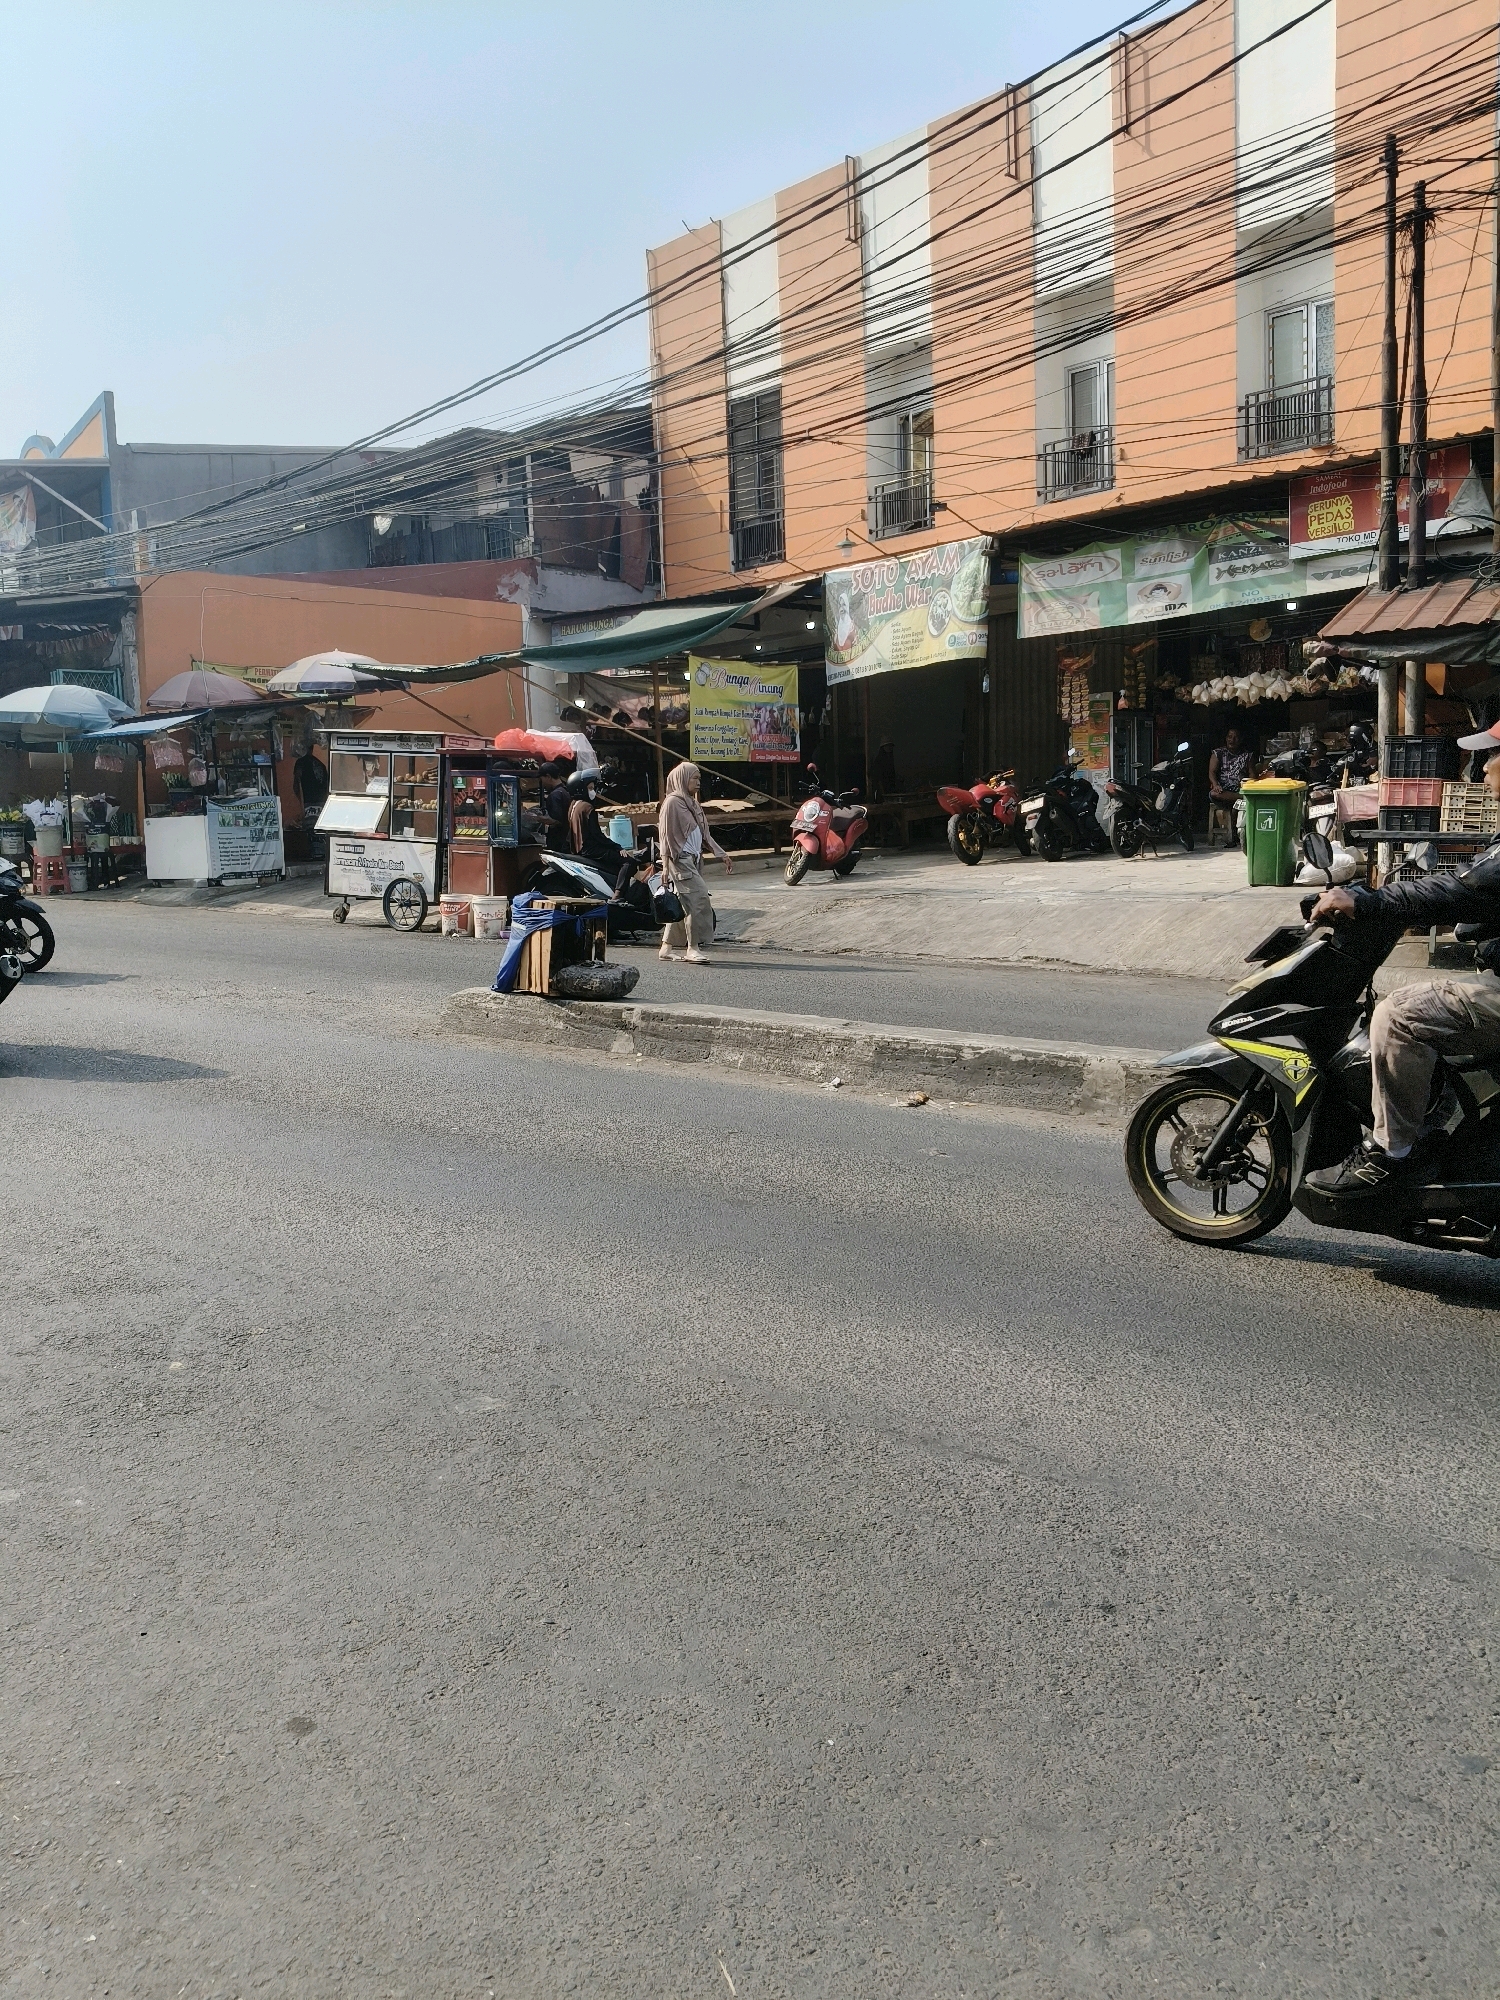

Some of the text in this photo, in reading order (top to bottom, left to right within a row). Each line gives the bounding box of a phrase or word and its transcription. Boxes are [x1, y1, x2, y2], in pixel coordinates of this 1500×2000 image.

[1309, 478, 1348, 495] Indofood
[1308, 497, 1352, 515] SERUNYA
[1309, 507, 1353, 527] PEDAS
[1309, 524, 1335, 538] VERSI
[1337, 534, 1361, 544] TOKO
[1363, 531, 1377, 541] MD
[1140, 549, 1190, 566] Sunfish
[852, 544, 961, 595] SOTO AYAM
[1036, 557, 1103, 579] salam
[868, 583, 932, 618] Budhe War
[1241, 589, 1260, 598] NO
[561, 618, 616, 637] HARUM BUNGA
[709, 667, 784, 698] Bunga Minang
[1221, 1016, 1255, 1029] HONDA
